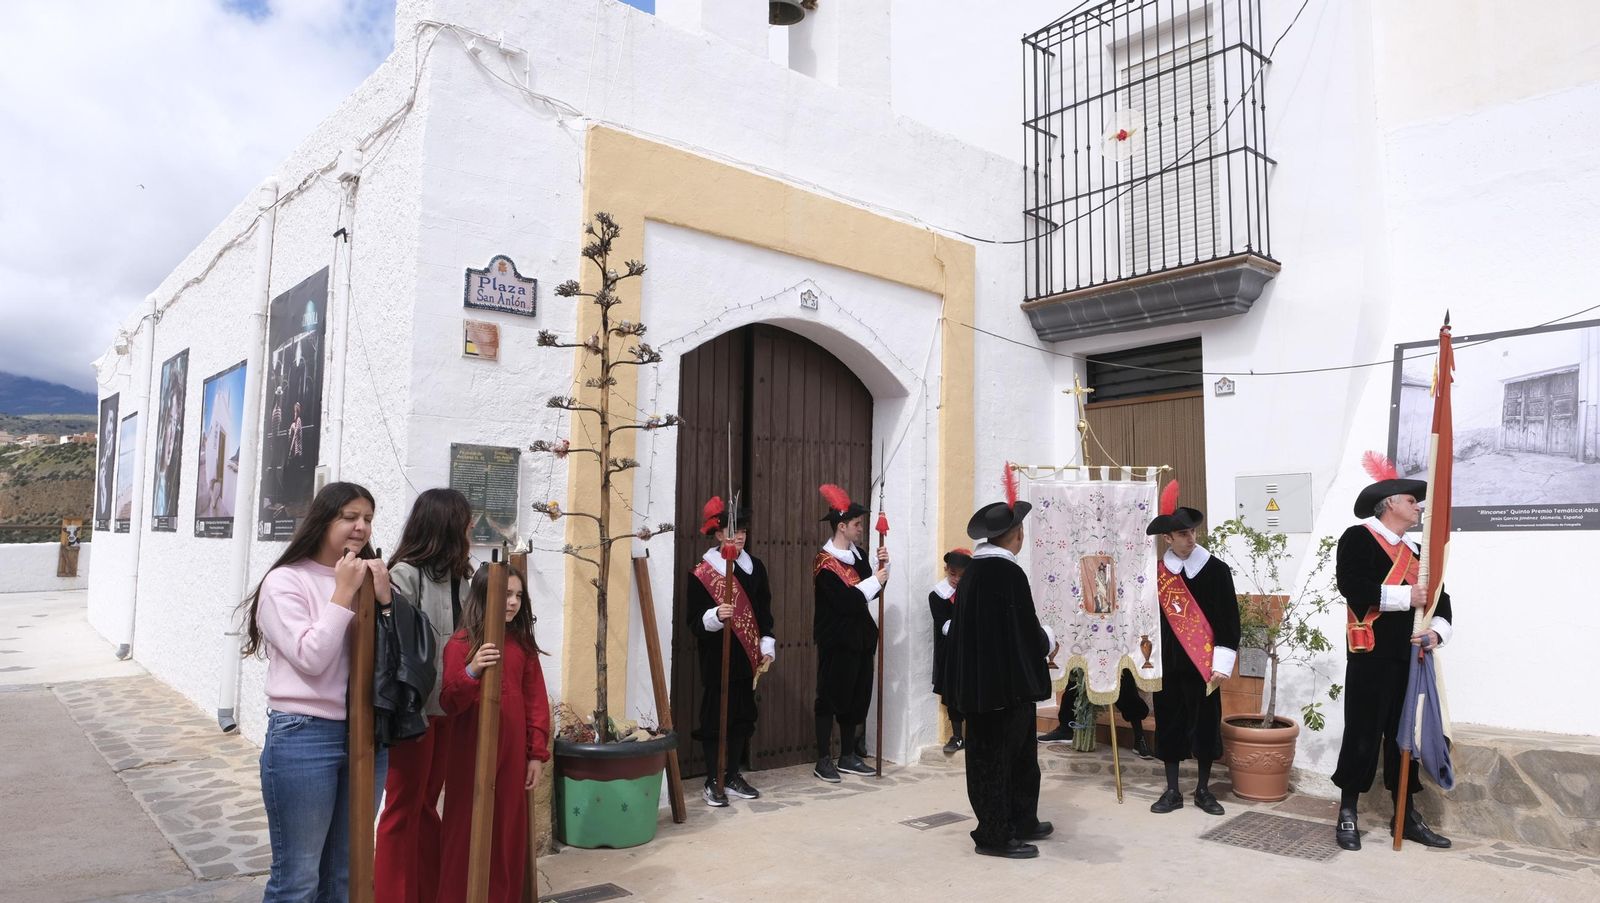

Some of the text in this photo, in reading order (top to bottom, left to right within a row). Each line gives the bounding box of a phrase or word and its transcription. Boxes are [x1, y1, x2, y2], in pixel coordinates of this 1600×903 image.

[478, 276, 526, 295] Plaza
[477, 288, 526, 309] San Antón
